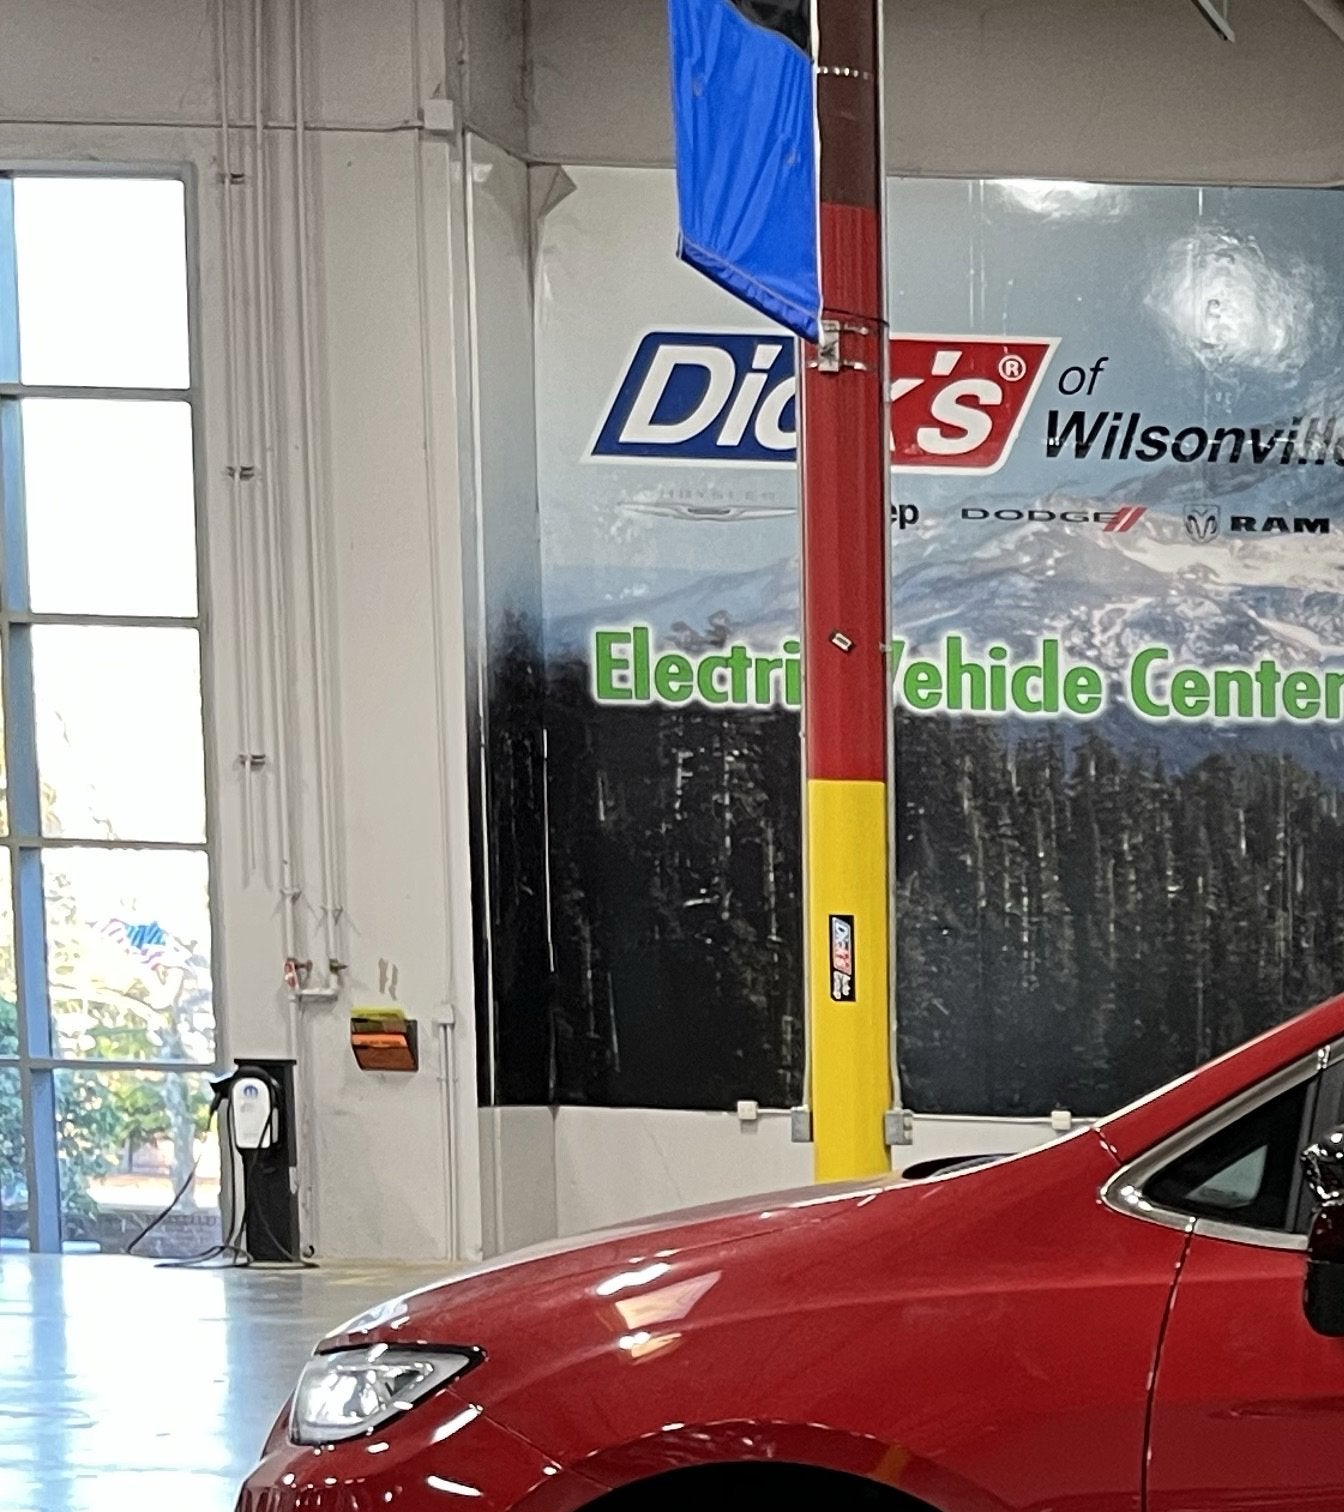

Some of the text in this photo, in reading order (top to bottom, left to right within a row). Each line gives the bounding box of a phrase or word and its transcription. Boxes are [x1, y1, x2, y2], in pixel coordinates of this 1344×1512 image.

[1057, 357, 1109, 396] of
[961, 507, 1119, 524] DODGE
[1230, 516, 1330, 534] RAM
[595, 626, 801, 705] Electri
